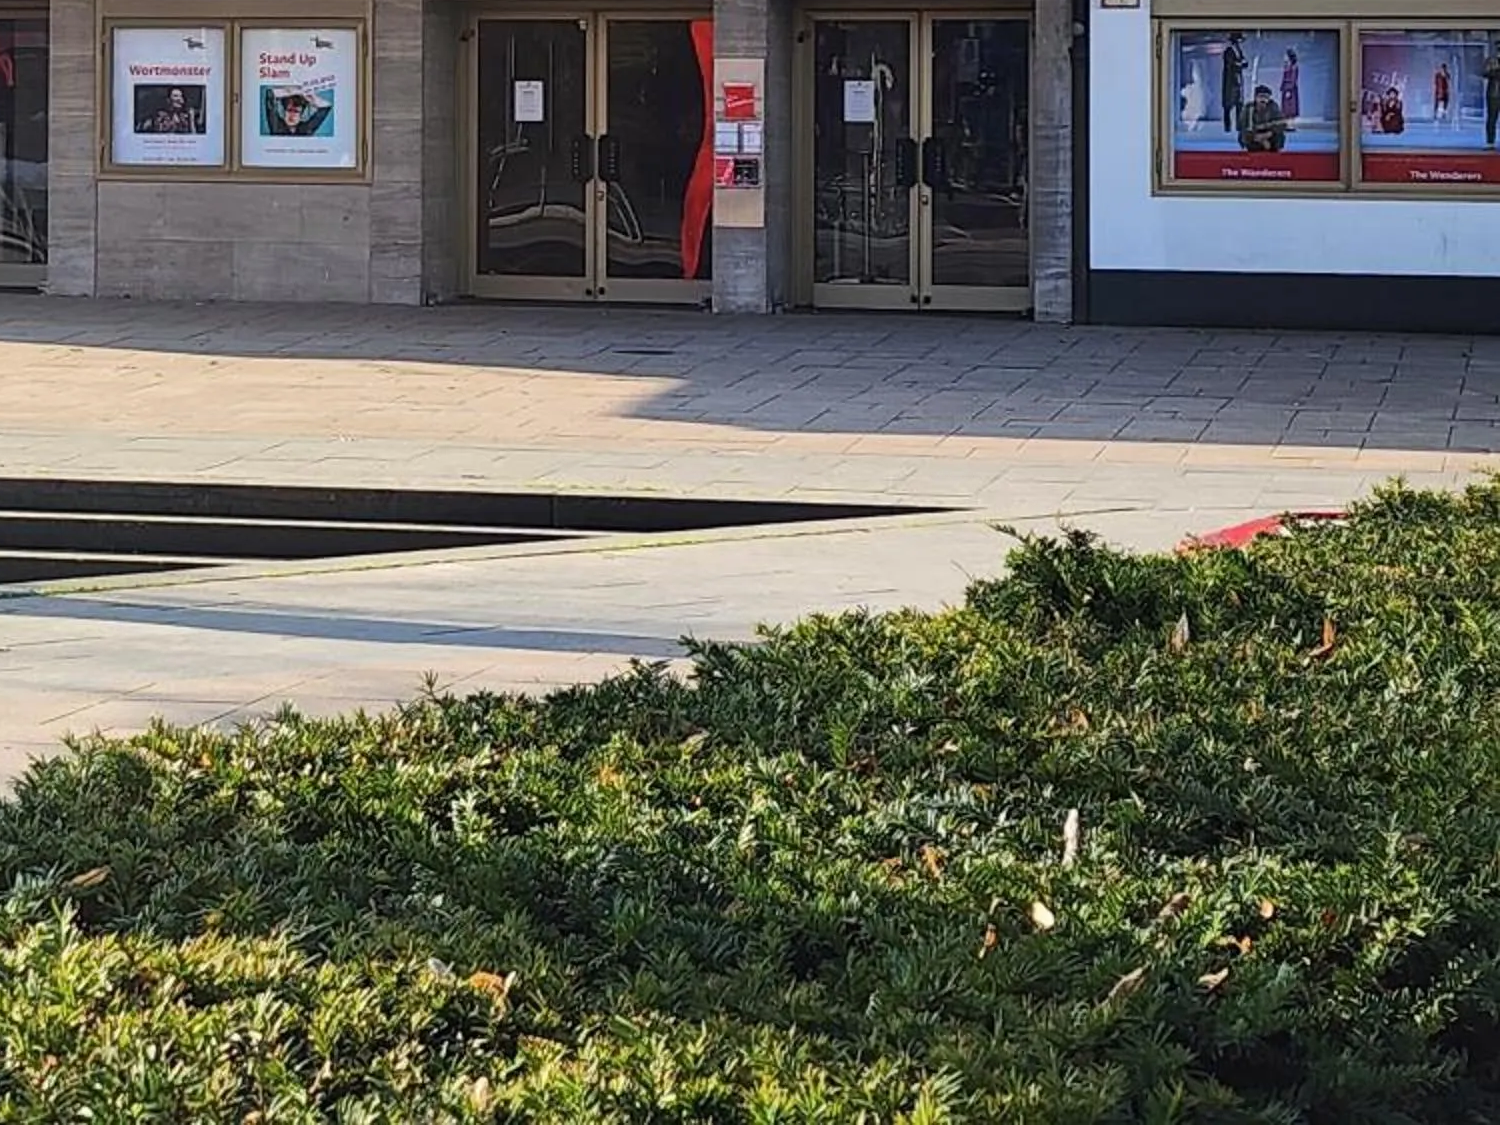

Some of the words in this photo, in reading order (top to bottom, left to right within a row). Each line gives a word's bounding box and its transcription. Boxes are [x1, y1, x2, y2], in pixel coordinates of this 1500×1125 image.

[259, 52, 296, 65] Stand
[299, 52, 317, 67] Up
[259, 67, 291, 79] Slam
